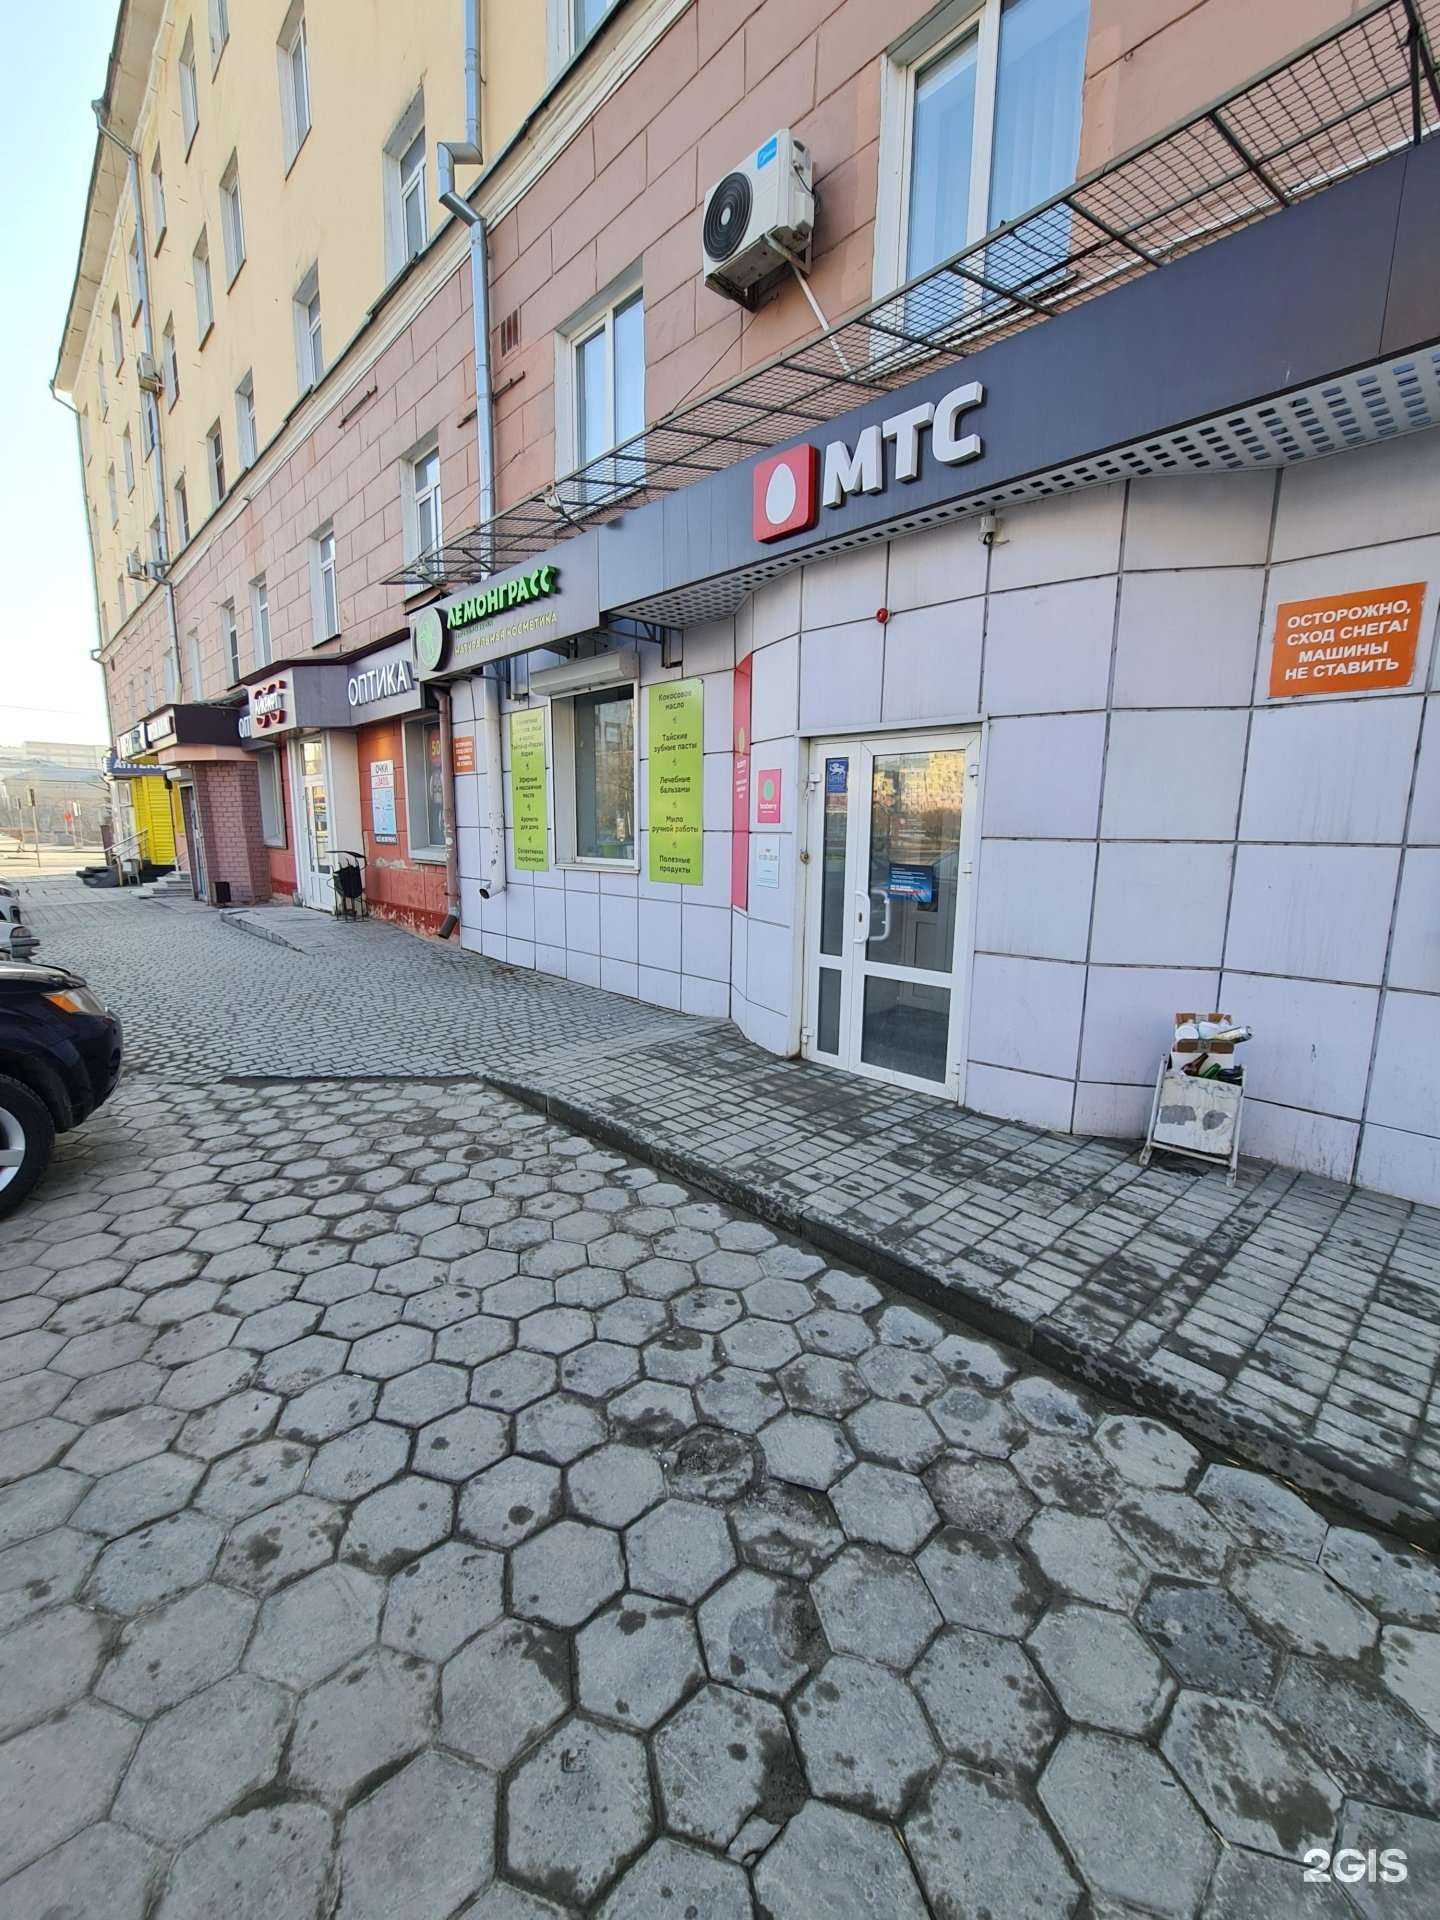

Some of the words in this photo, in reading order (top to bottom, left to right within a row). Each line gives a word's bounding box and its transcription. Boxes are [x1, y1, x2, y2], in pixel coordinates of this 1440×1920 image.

[823, 380, 983, 507] МТС
[447, 565, 556, 629] ЛЕМОНГРАСС
[506, 612, 557, 637] КОСМЕТИКА
[1287, 600, 1411, 629] ОСТОРОЖНО,
[1287, 629, 1335, 646] СХОД
[1340, 619, 1409, 640] СНЕГА!
[1298, 641, 1389, 663] МАШИНЫ
[348, 660, 410, 706] ОПТИКА
[1285, 667, 1309, 681] НЕ
[1313, 658, 1400, 678] СТАВИТЬ
